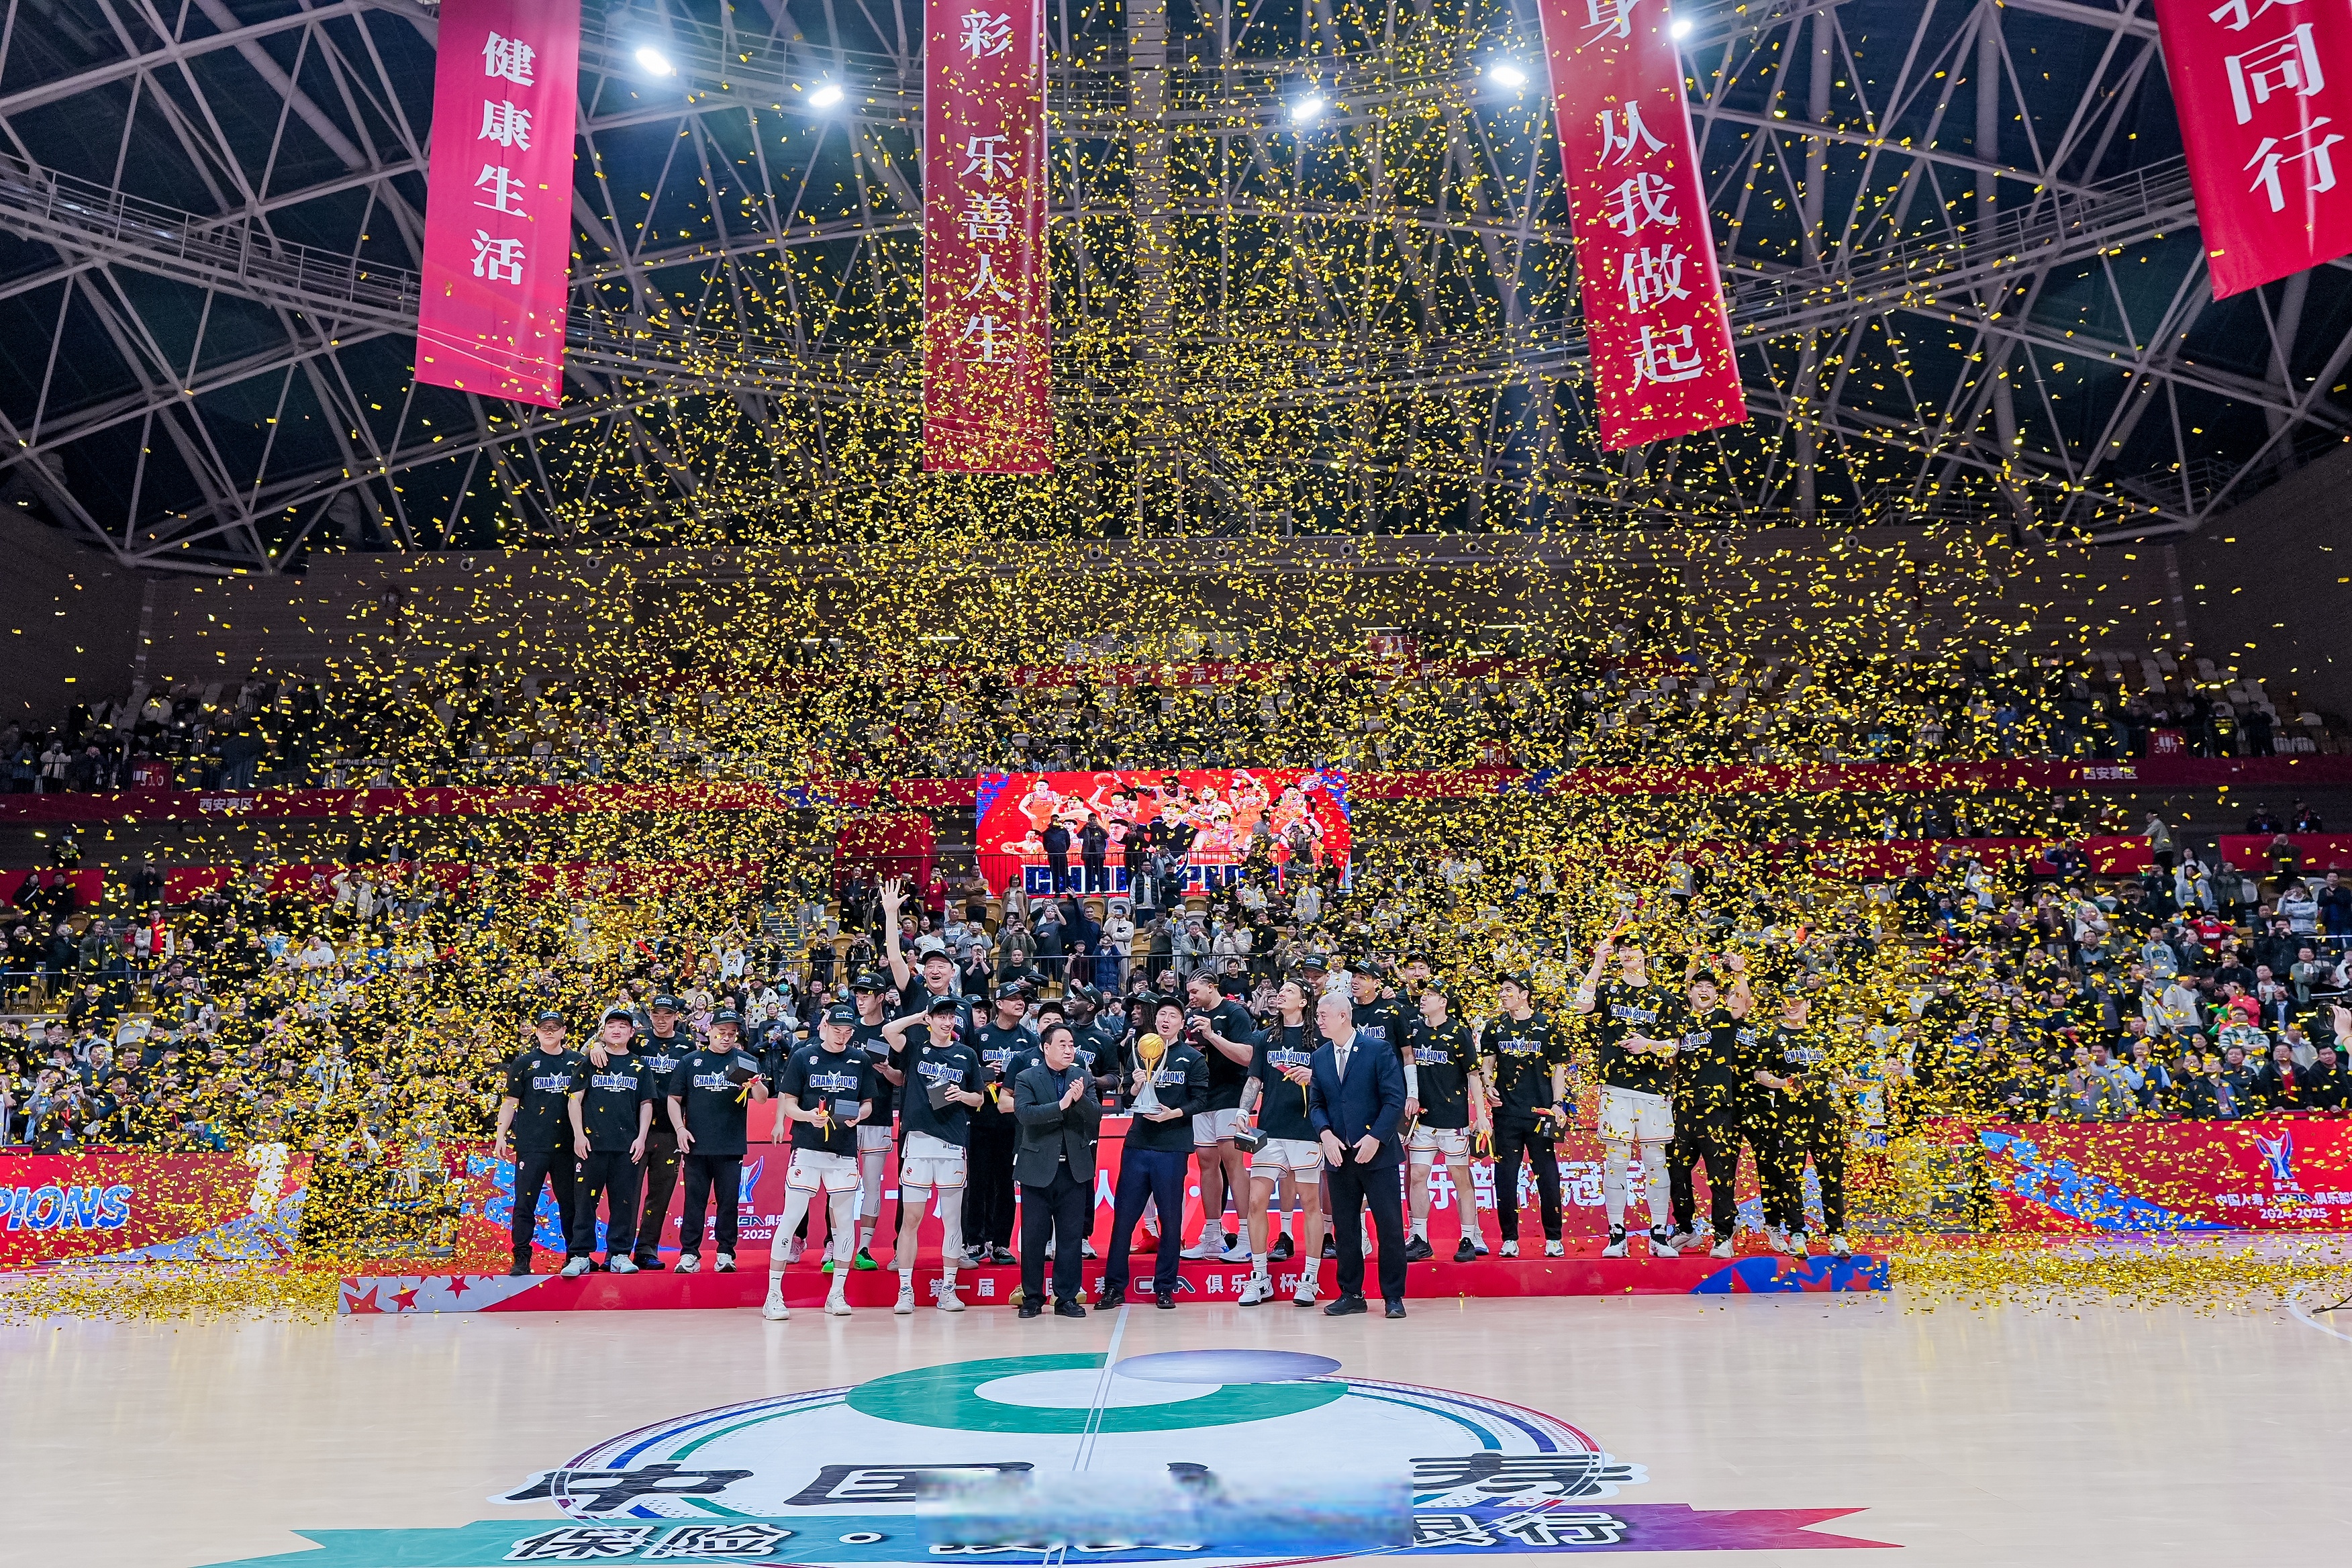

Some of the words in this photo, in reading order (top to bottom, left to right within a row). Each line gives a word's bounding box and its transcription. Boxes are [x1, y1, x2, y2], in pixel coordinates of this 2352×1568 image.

[960, 9, 1012, 59] 彩
[470, 30, 536, 287] 健康生活
[960, 132, 1015, 366] 乐善人生
[1599, 99, 1704, 393] 从我做起
[1267, 1049, 1310, 1065] CHAMPIONS
[592, 1074, 638, 1090] CHAMPIONS
[810, 1073, 858, 1090] CHAMPIONS
[917, 1061, 964, 1083] CHAMPIONS
[2259, 1208, 2328, 1219] 2024-2025
[1206, 1273, 1297, 1294] 俱乐杯
